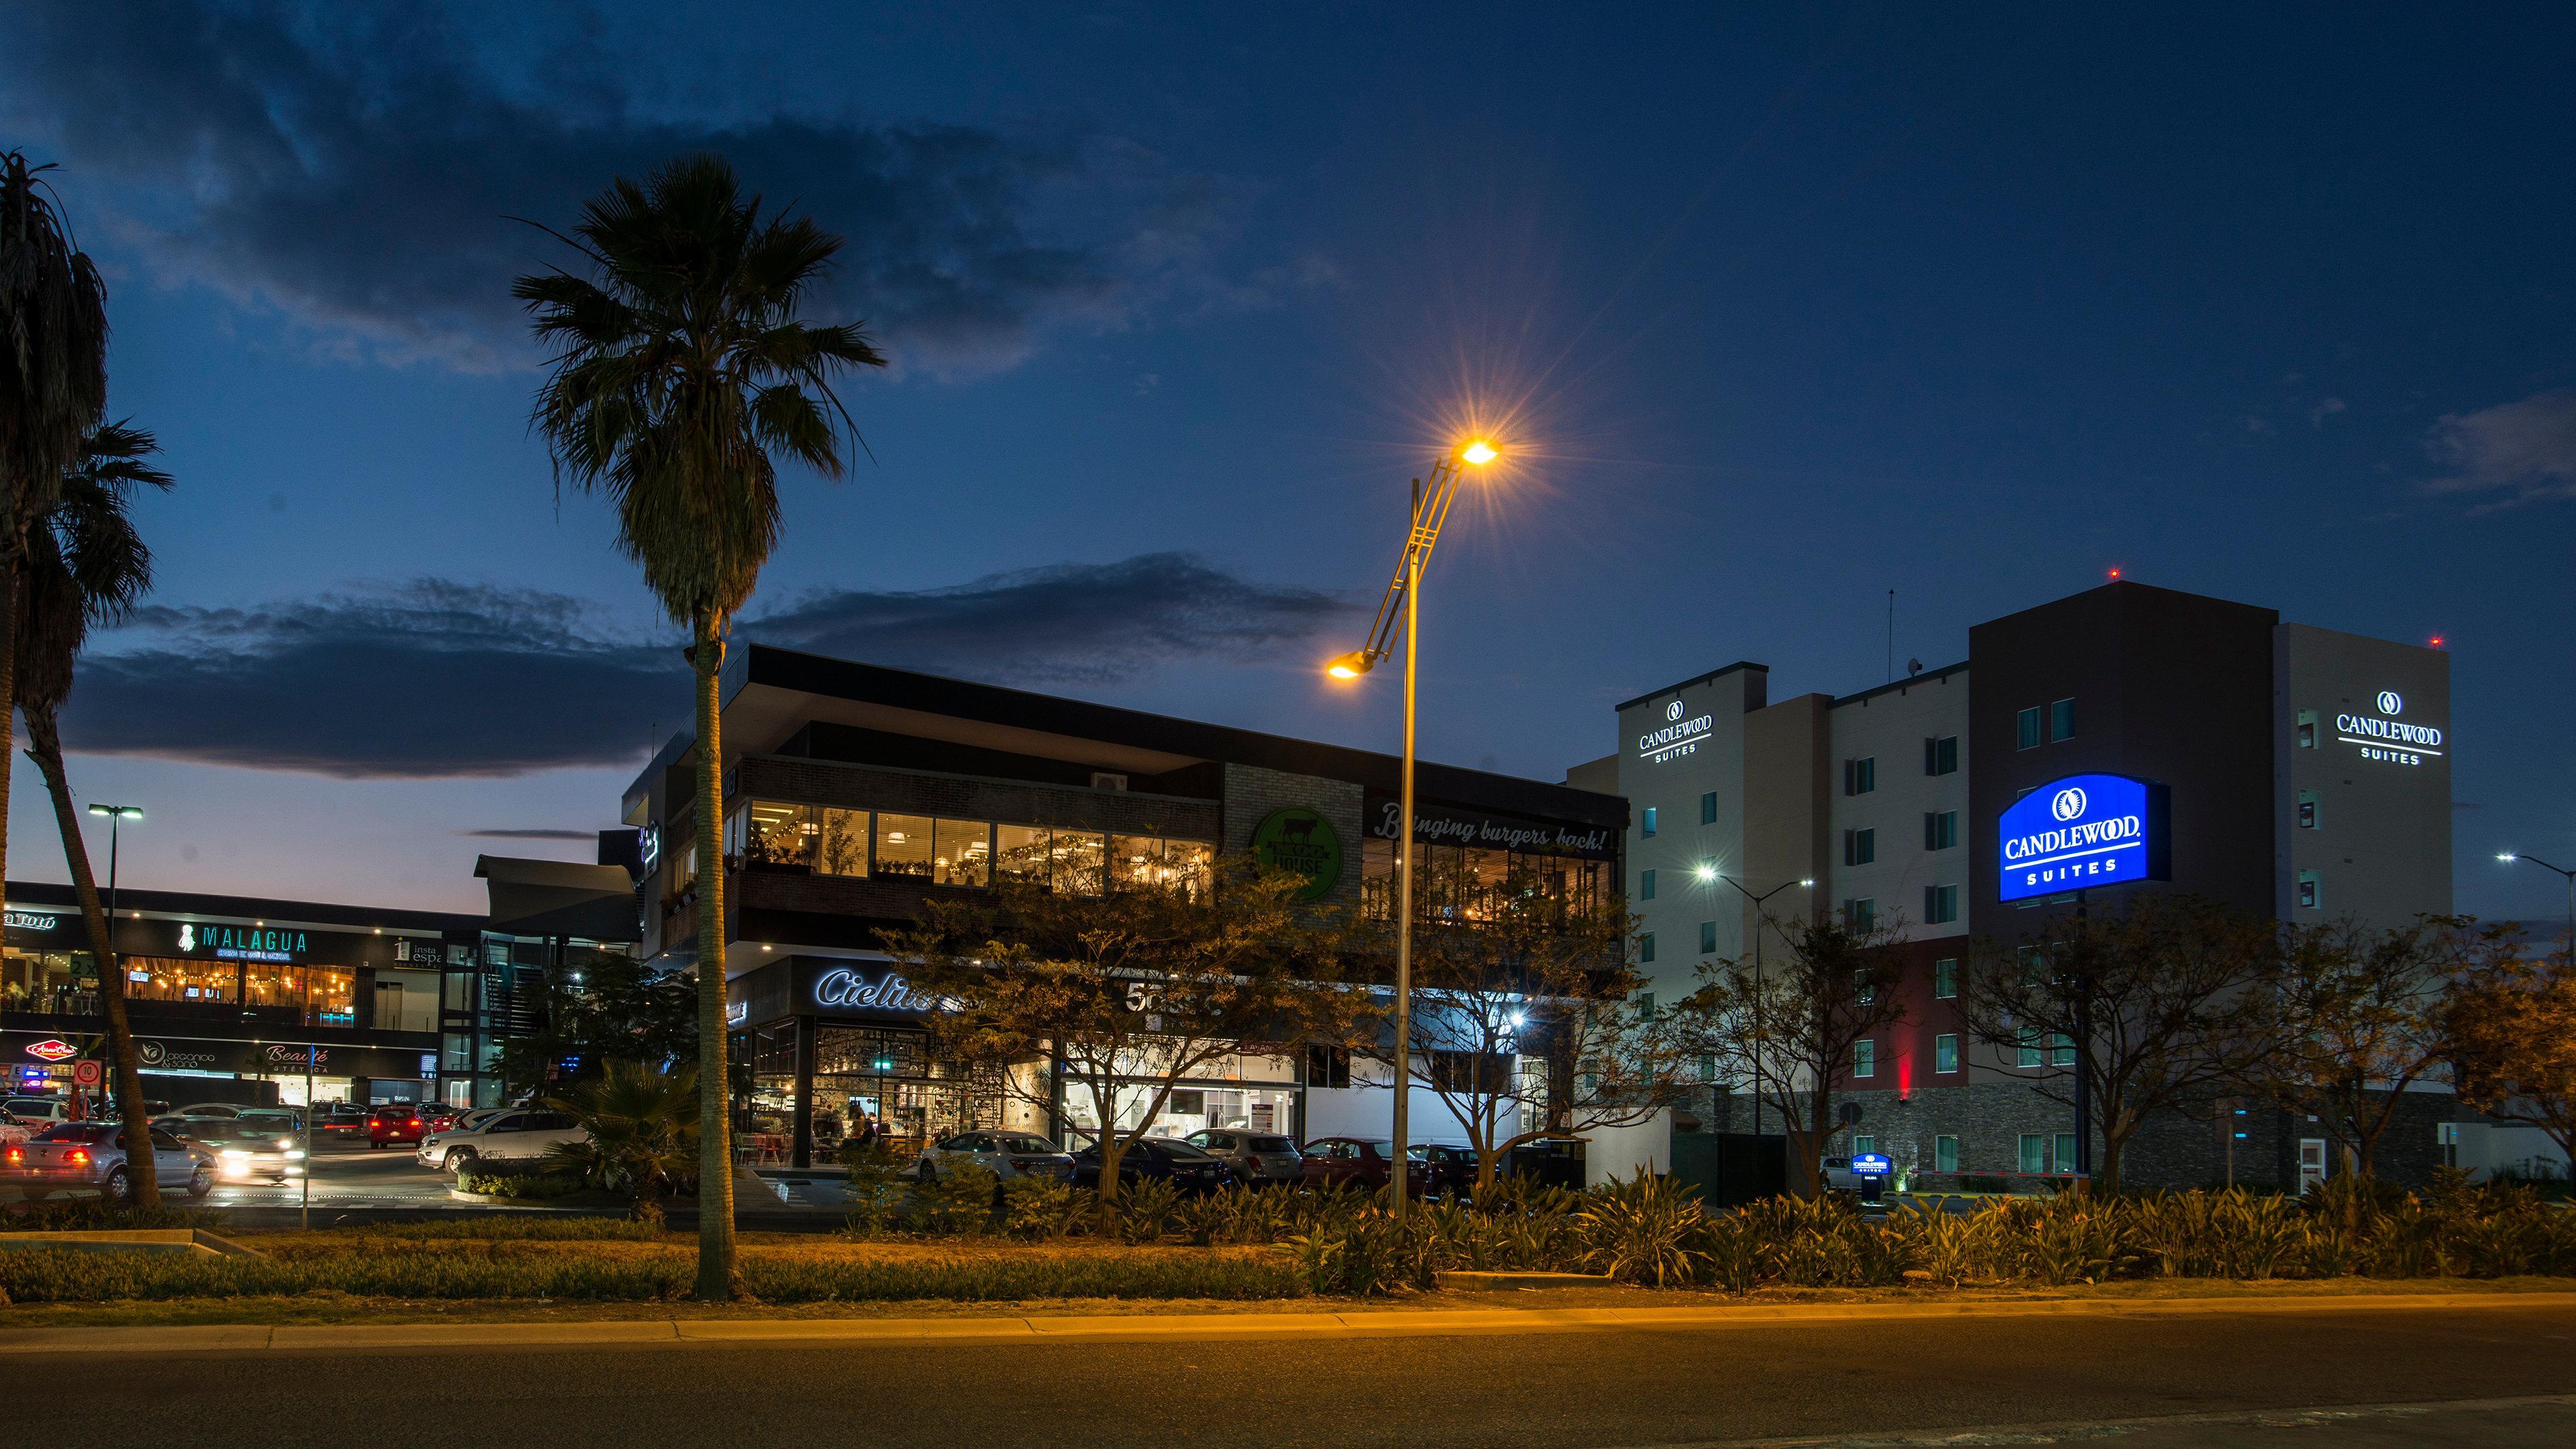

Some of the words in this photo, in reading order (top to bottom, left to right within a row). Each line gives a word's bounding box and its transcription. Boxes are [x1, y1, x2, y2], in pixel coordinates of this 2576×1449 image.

[1640, 715, 1713, 750] CANDLEWOOD
[2337, 714, 2440, 746] CANDLEWOOD
[1655, 744, 1696, 763] SUITES
[2361, 747, 2420, 765] SUITES
[1375, 802, 1476, 843] Binging
[1480, 820, 1550, 848] burgers
[1556, 827, 1607, 851] back!
[2027, 859, 2116, 885] SUITES
[203, 927, 306, 952] MALAGUA
[415, 945, 435, 954] insta
[84, 1066, 92, 1075] 10
